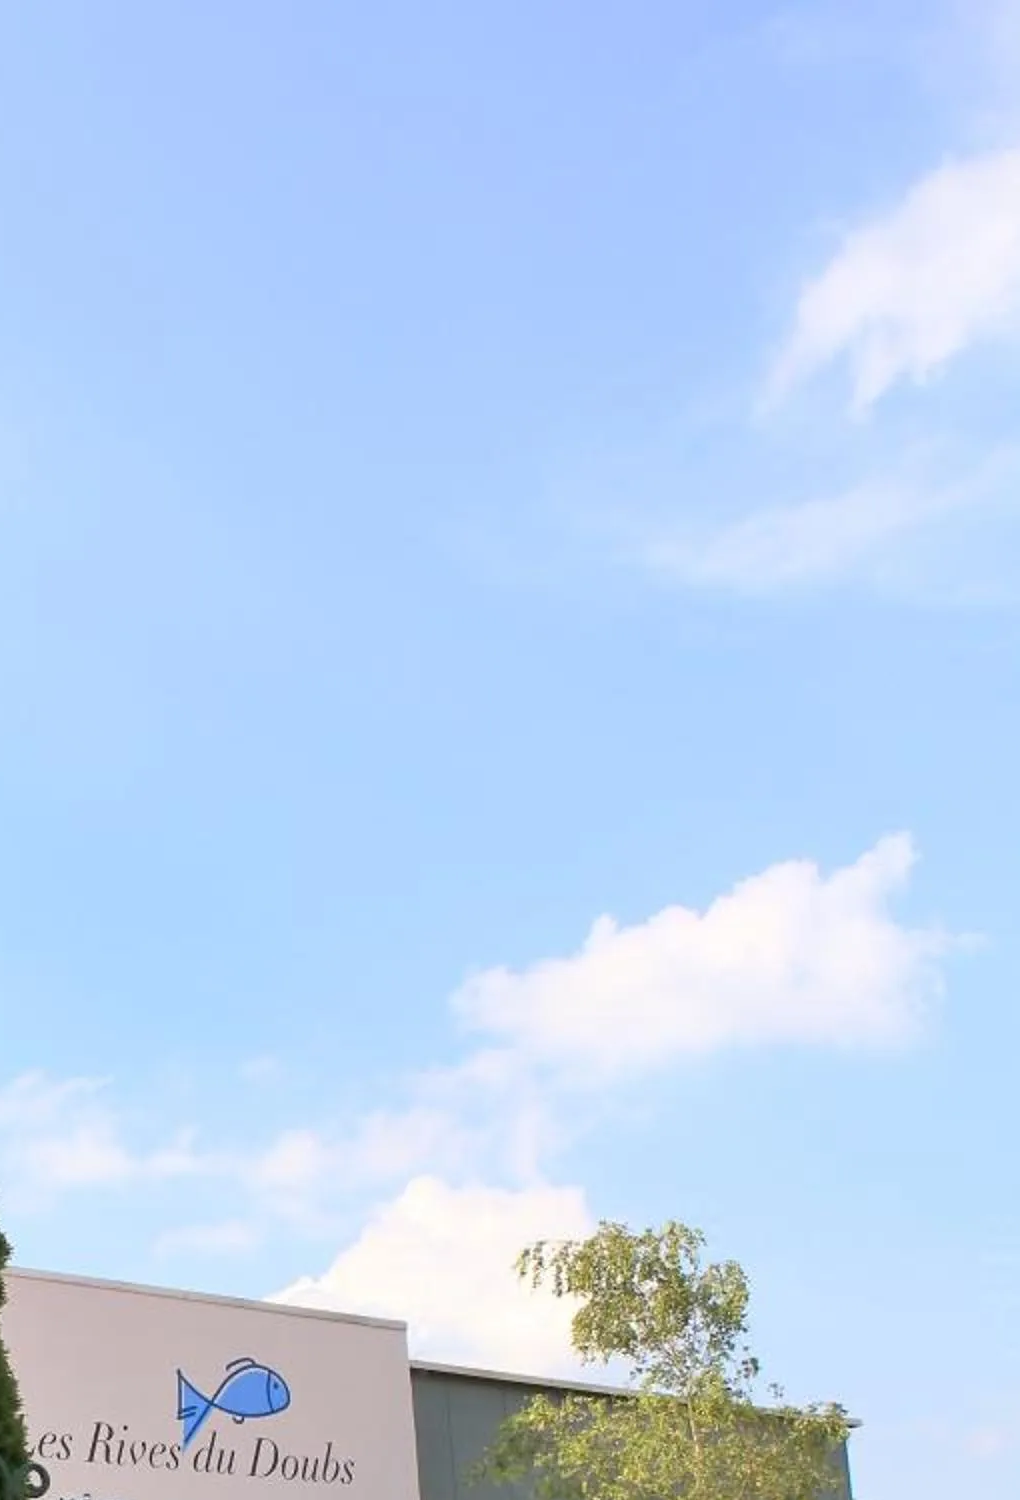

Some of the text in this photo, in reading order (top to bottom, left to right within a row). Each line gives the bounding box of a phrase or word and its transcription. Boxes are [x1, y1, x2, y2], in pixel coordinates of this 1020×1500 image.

[28, 1421, 356, 1485] es Rives du Doubs
